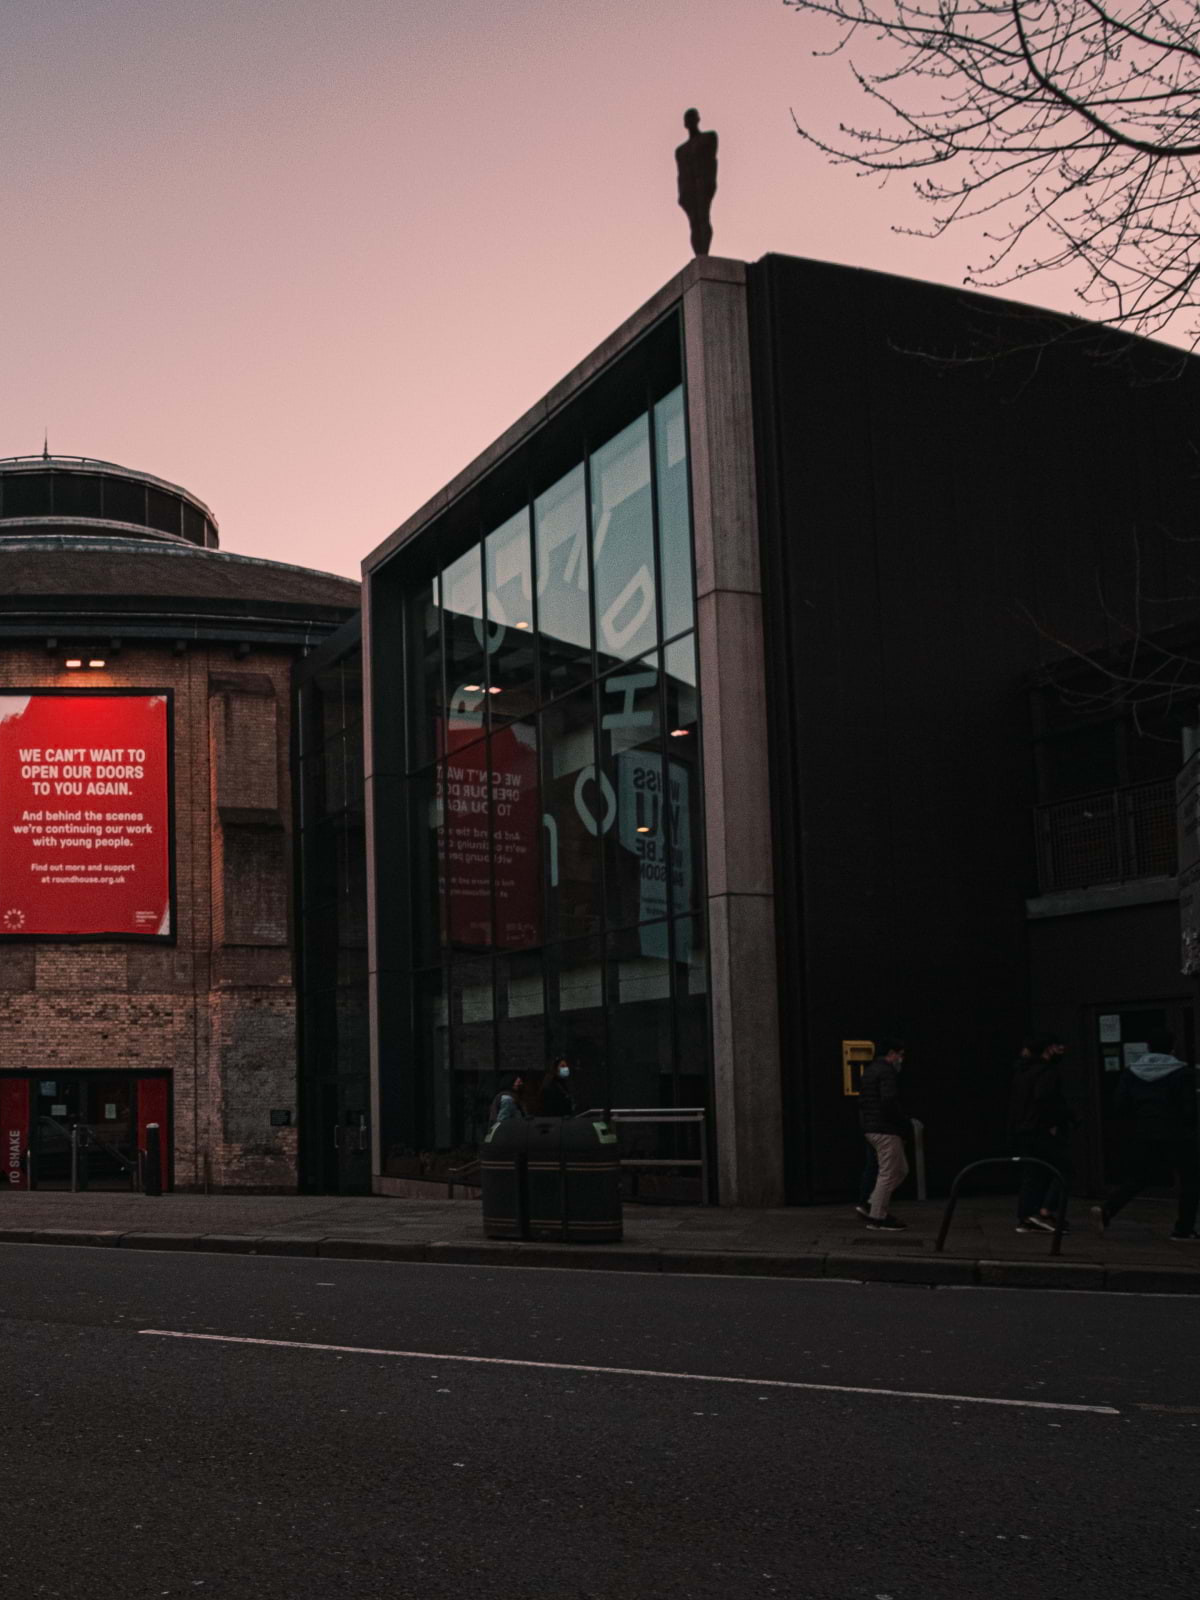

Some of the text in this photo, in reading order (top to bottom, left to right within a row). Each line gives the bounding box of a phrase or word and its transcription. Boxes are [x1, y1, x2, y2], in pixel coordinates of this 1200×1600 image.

[19, 749, 145, 762] WE CAN'T WAIT TO
[22, 766, 143, 778] OPEN OUR DOORS
[32, 782, 132, 795] TO YOU AGAIN.
[23, 811, 42, 820] And
[46, 811, 81, 820] behind
[85, 811, 102, 820] the
[14, 824, 42, 833] we're
[46, 824, 102, 836] continuing
[126, 824, 152, 833] work
[33, 837, 133, 850] with young people.
[31, 864, 48, 872] Find
[50, 864, 63, 872] out
[88, 864, 102, 872] and
[104, 864, 135, 873] support
[52, 876, 125, 885] roundhouse.org.uk
[9, 1130, 21, 1183] TO SHAKE
